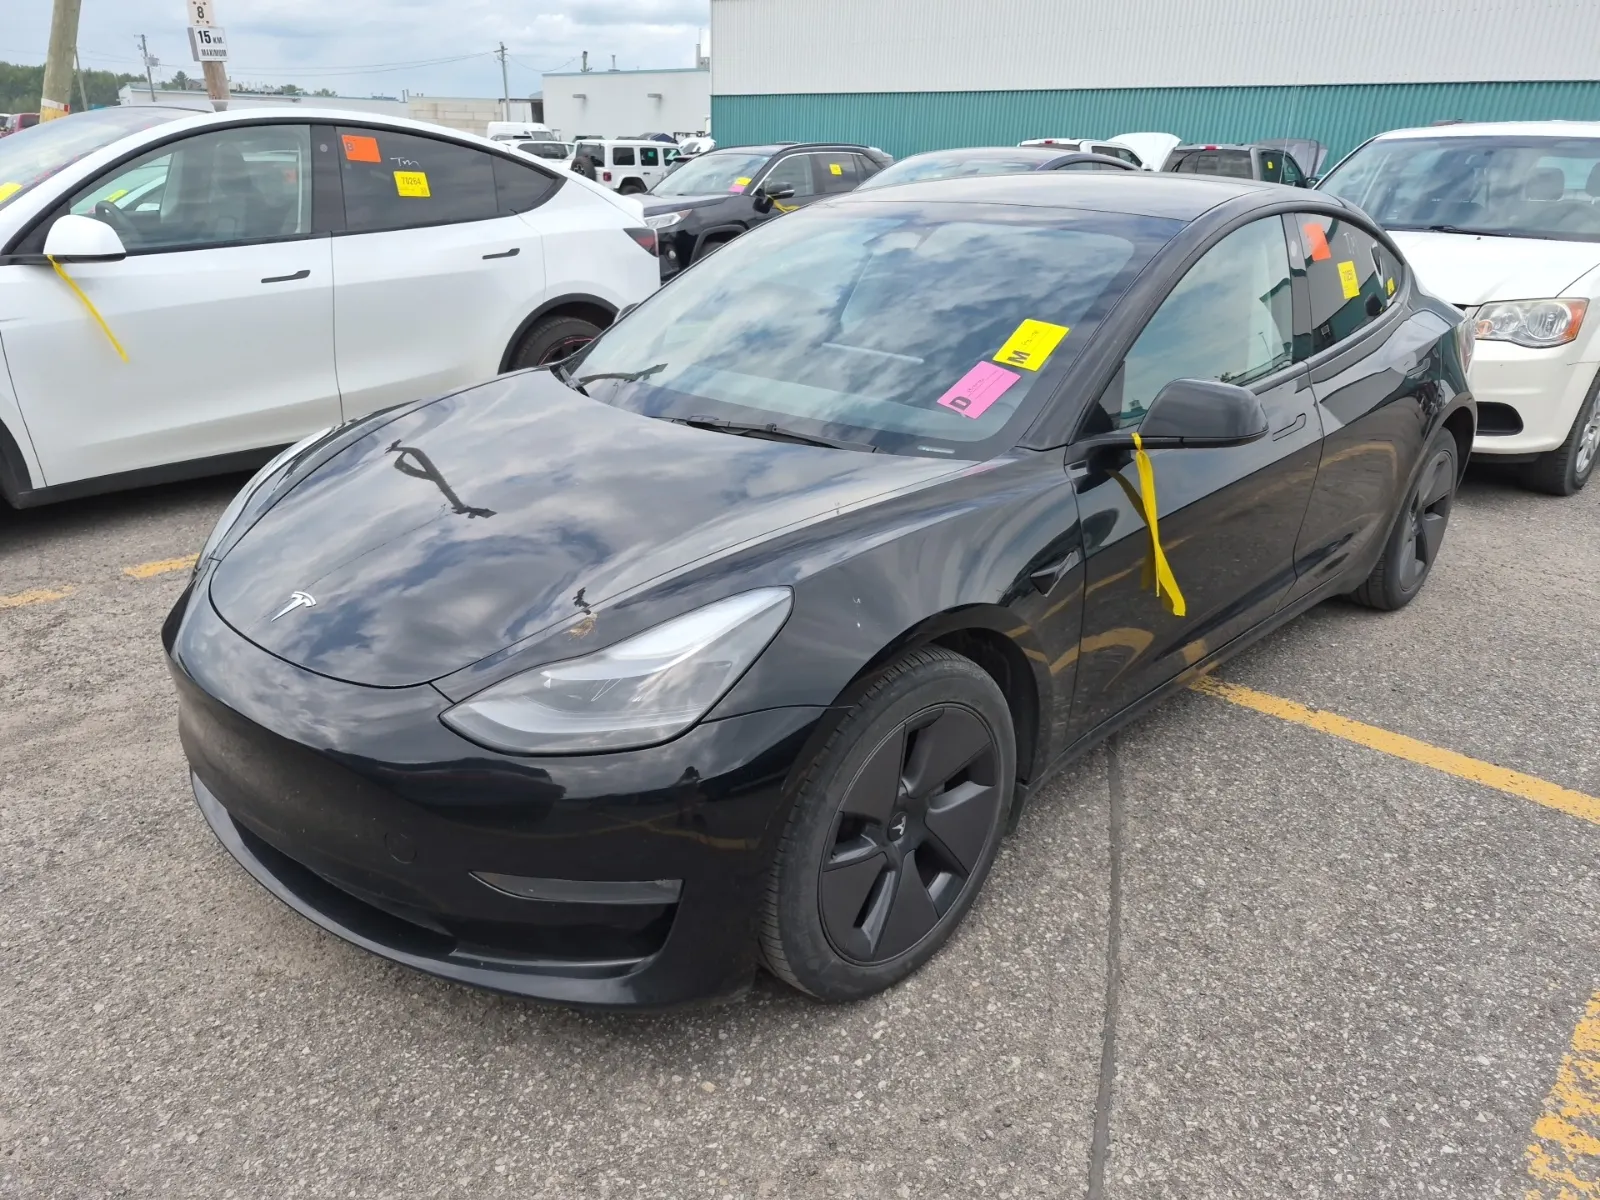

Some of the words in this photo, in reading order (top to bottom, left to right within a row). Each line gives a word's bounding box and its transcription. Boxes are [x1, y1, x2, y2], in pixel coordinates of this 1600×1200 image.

[197, 6, 204, 19] 8
[197, 30, 212, 44] 15
[1006, 350, 1031, 364] M
[949, 396, 972, 411] D
